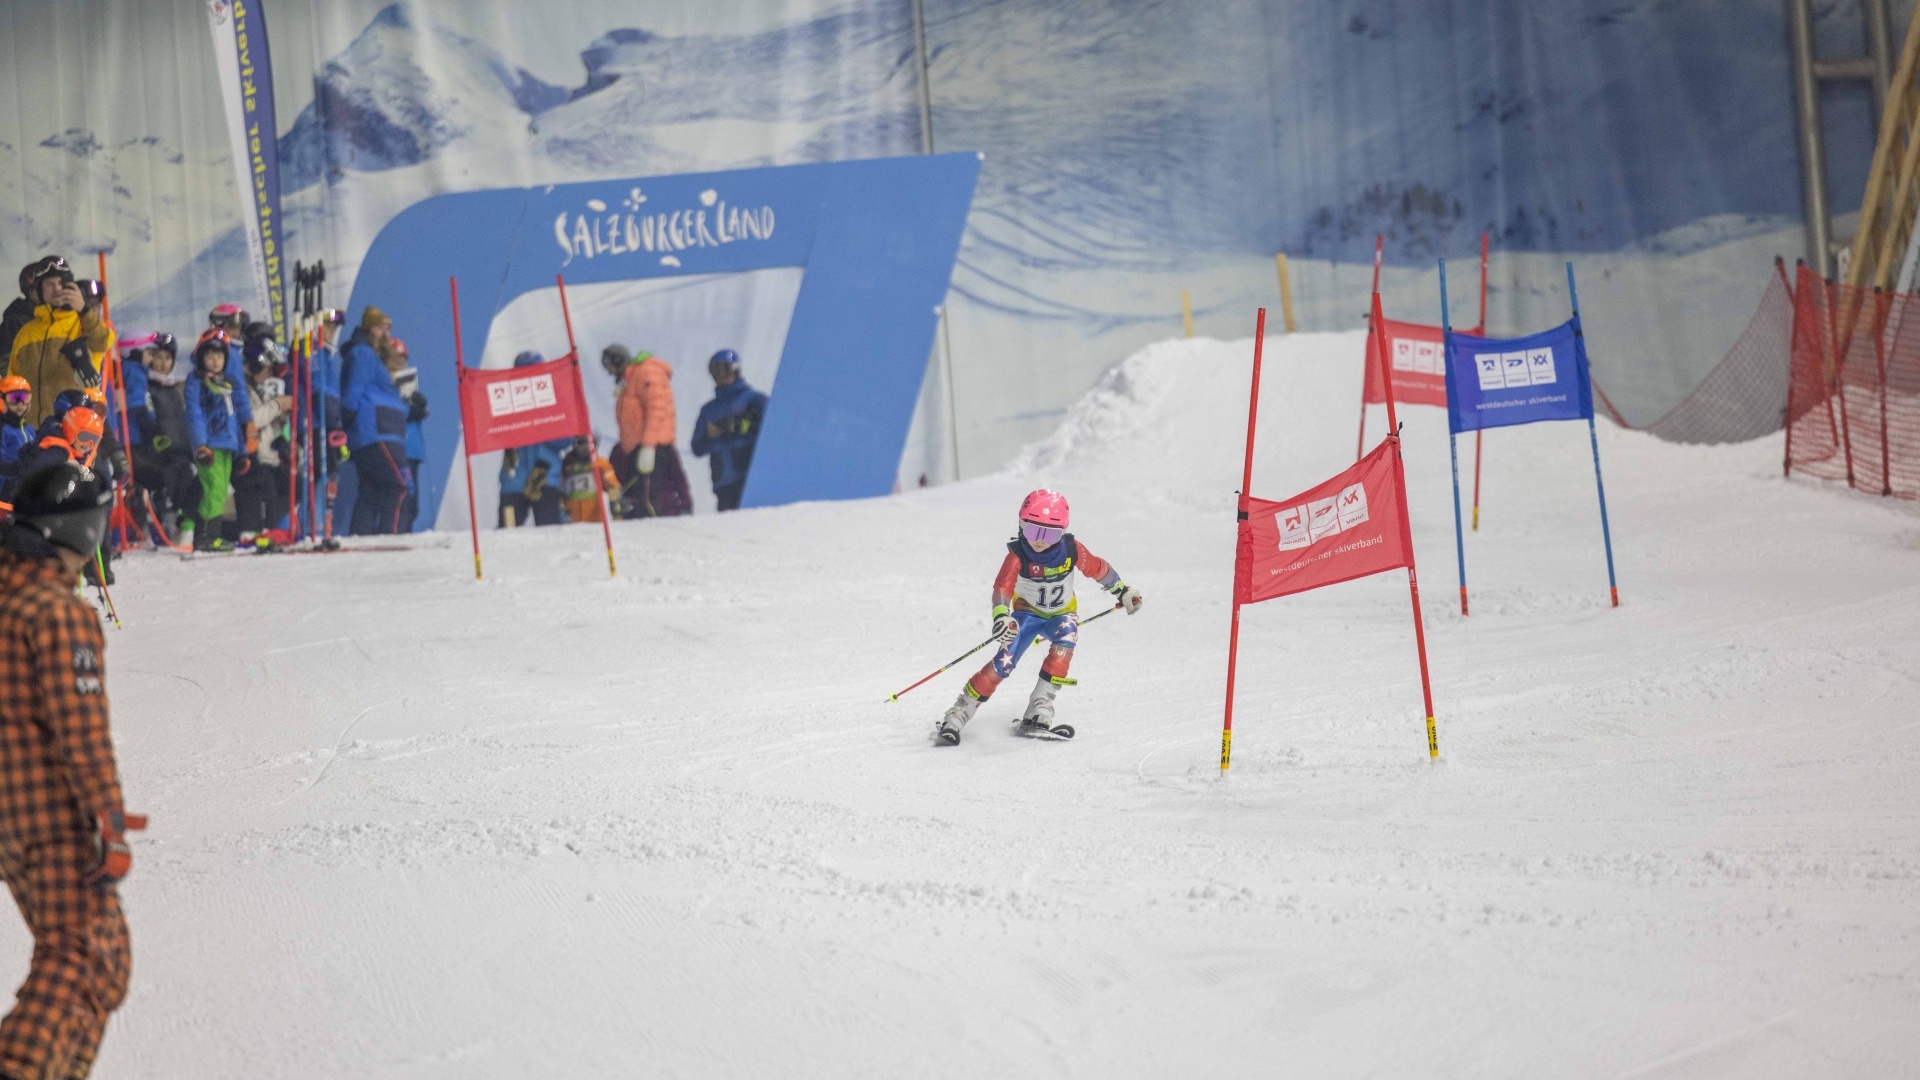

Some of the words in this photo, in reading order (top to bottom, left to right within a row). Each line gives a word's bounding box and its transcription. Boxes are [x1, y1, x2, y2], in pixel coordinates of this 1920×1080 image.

[1475, 398, 1526, 410] westdeutscher
[1528, 394, 1567, 405] skiverband
[1270, 550, 1333, 576] westdeutscher
[1334, 534, 1383, 555] skiverband
[1036, 584, 1065, 609] 12
